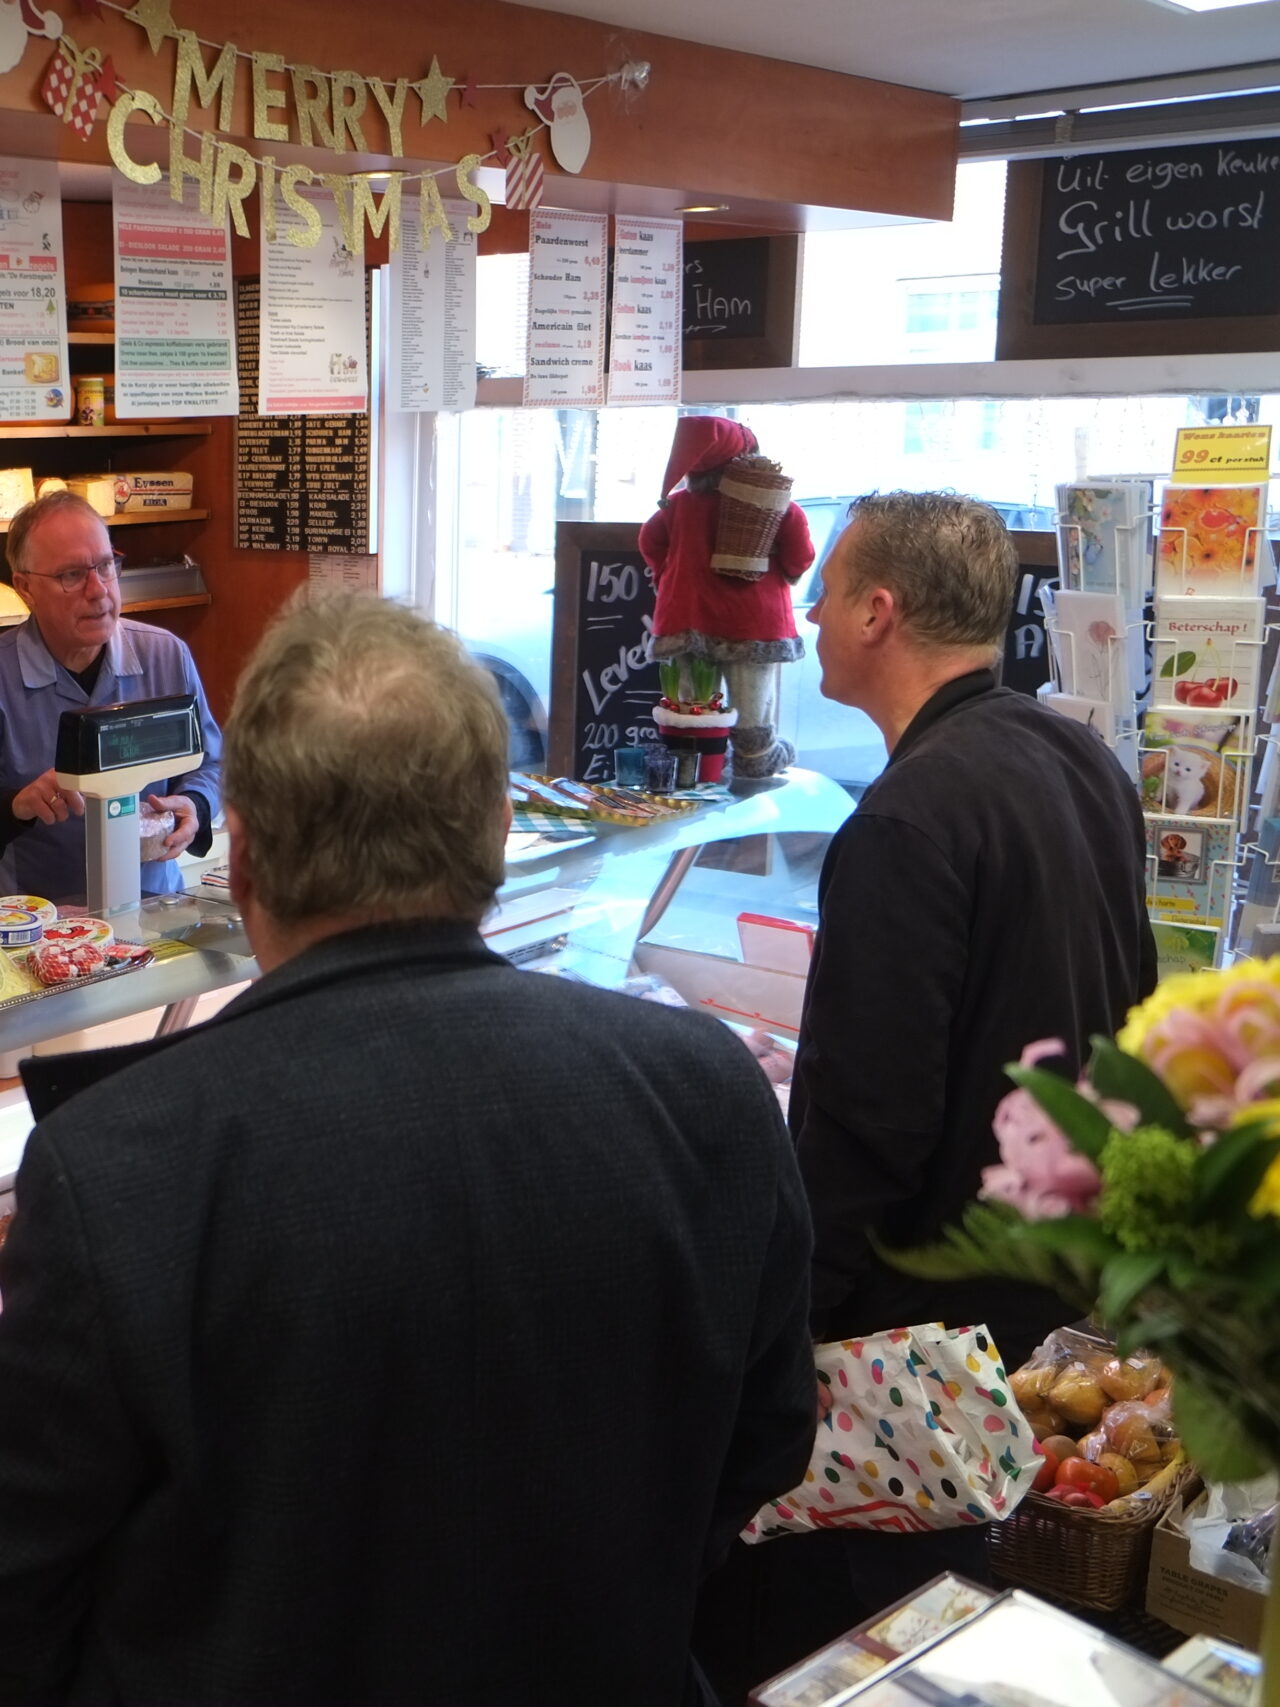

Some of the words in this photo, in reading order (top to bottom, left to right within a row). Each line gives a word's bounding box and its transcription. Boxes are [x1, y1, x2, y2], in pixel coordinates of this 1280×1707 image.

[172, 29, 409, 158] MERRY
[107, 90, 492, 256] CHRISTMAS
[1126, 160, 1203, 190] eigen
[1057, 198, 1153, 260] Grill
[1166, 190, 1264, 230] worst
[535, 235, 589, 247] Paardenworst
[639, 230, 654, 241] kaas
[565, 273, 581, 282] Ham
[655, 276, 667, 285] kaas
[637, 304, 652, 314] kaas
[695, 288, 751, 320] HAM
[532, 322, 573, 331] Americain
[577, 322, 591, 331] filet
[530, 357, 570, 366] Sandwich
[634, 360, 653, 371] kaas
[1218, 431, 1266, 439] kaarten
[1180, 449, 1210, 464] 99
[587, 561, 638, 603] 150
[1168, 621, 1240, 637] Beterschap
[583, 722, 618, 750] 200
